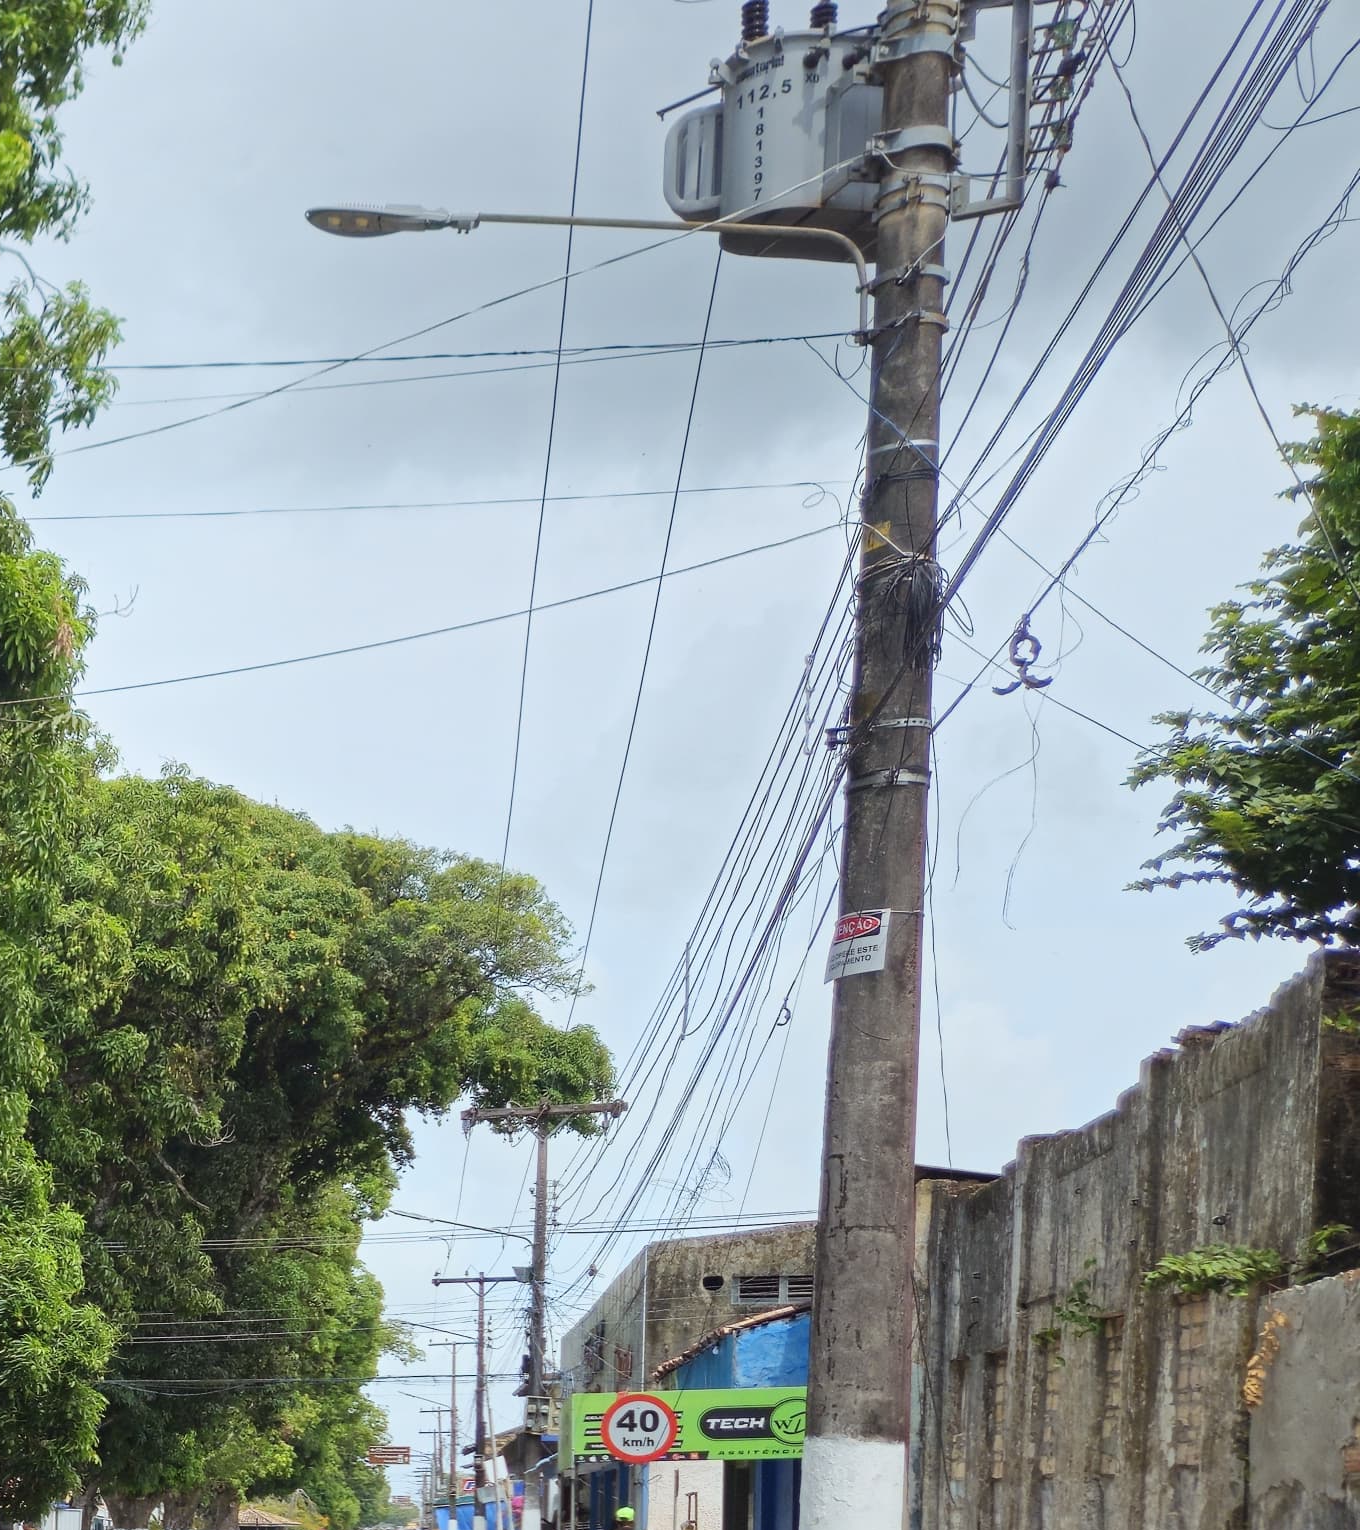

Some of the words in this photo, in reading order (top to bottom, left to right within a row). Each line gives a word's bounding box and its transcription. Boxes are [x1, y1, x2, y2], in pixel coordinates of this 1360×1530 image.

[737, 79, 792, 109] 112,5
[754, 106, 764, 200] 181397
[838, 918, 873, 936] ENÇÃO
[857, 944, 879, 954] ESTE
[616, 1409, 659, 1432] 40
[706, 1417, 765, 1430] TECH
[622, 1437, 655, 1447] km/h
